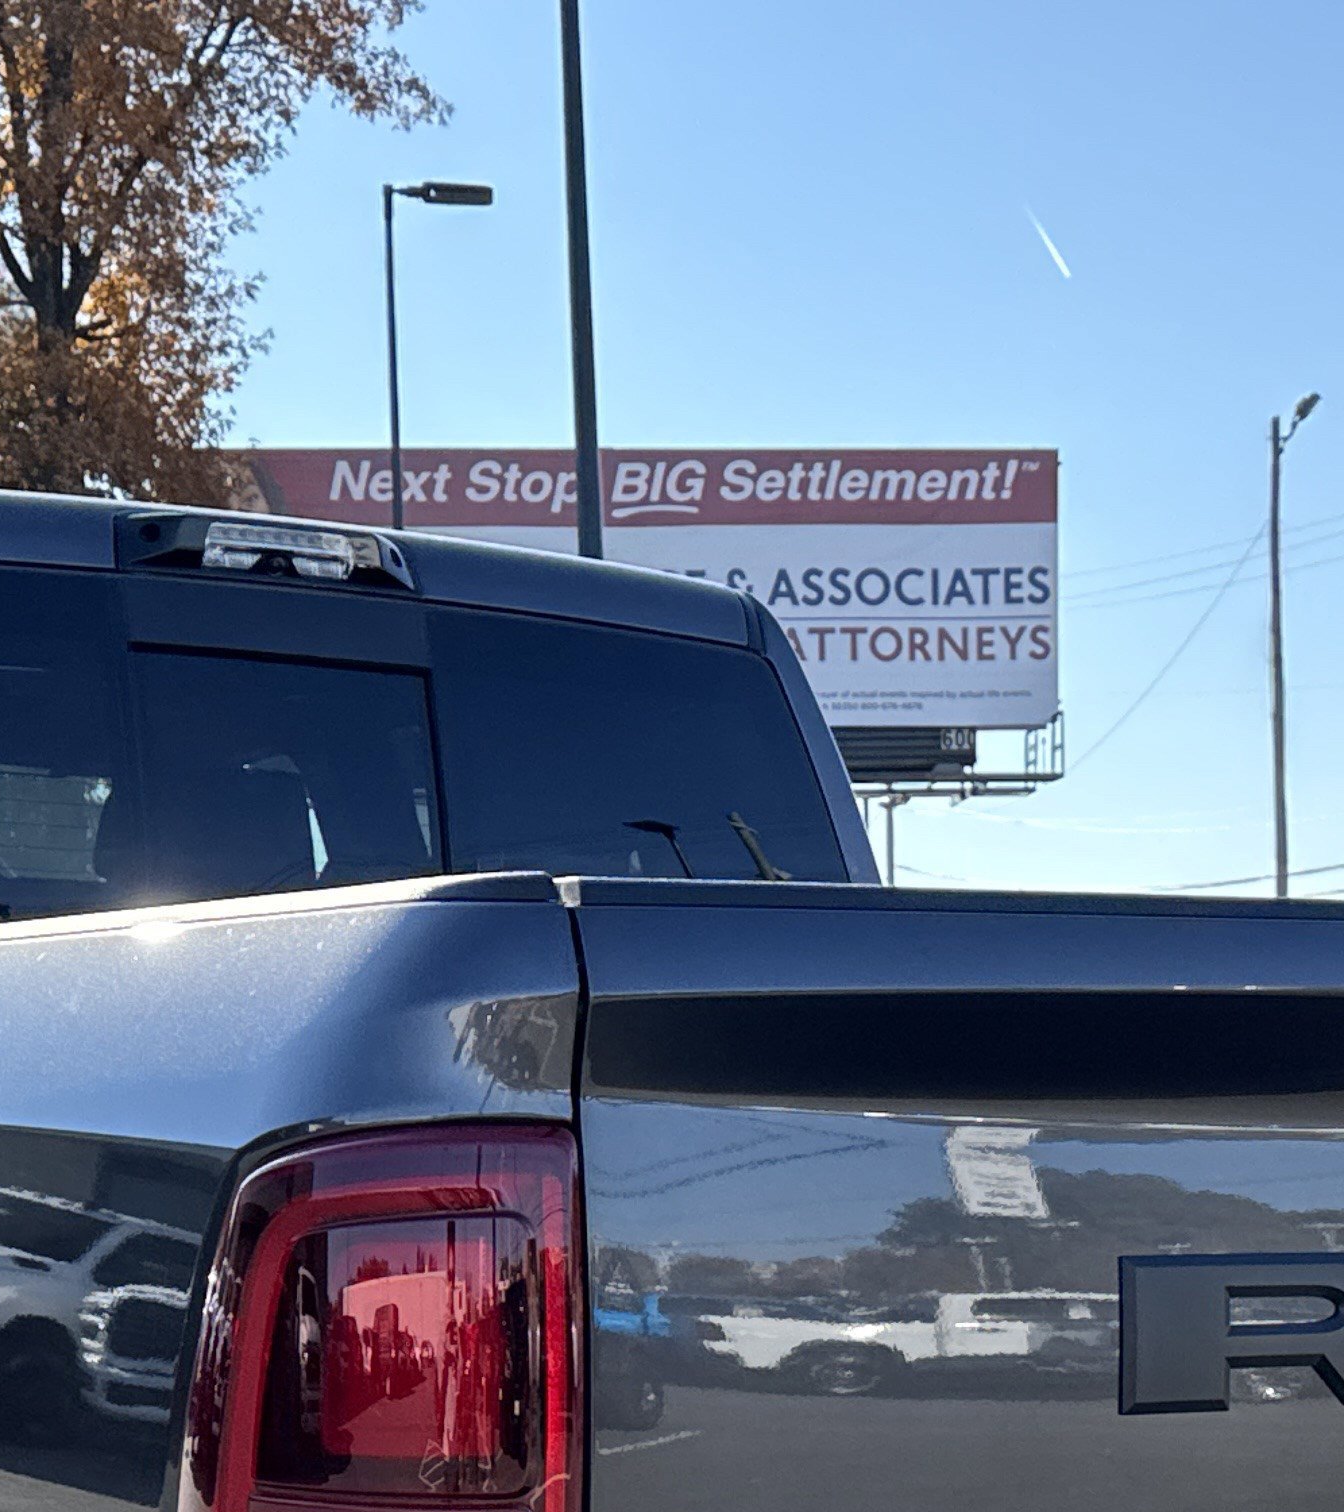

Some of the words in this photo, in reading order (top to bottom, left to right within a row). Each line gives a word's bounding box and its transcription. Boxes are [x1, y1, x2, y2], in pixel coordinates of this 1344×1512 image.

[329, 459, 453, 501] Next
[610, 459, 707, 502] BIG
[767, 566, 1052, 606] ASSOCIATES
